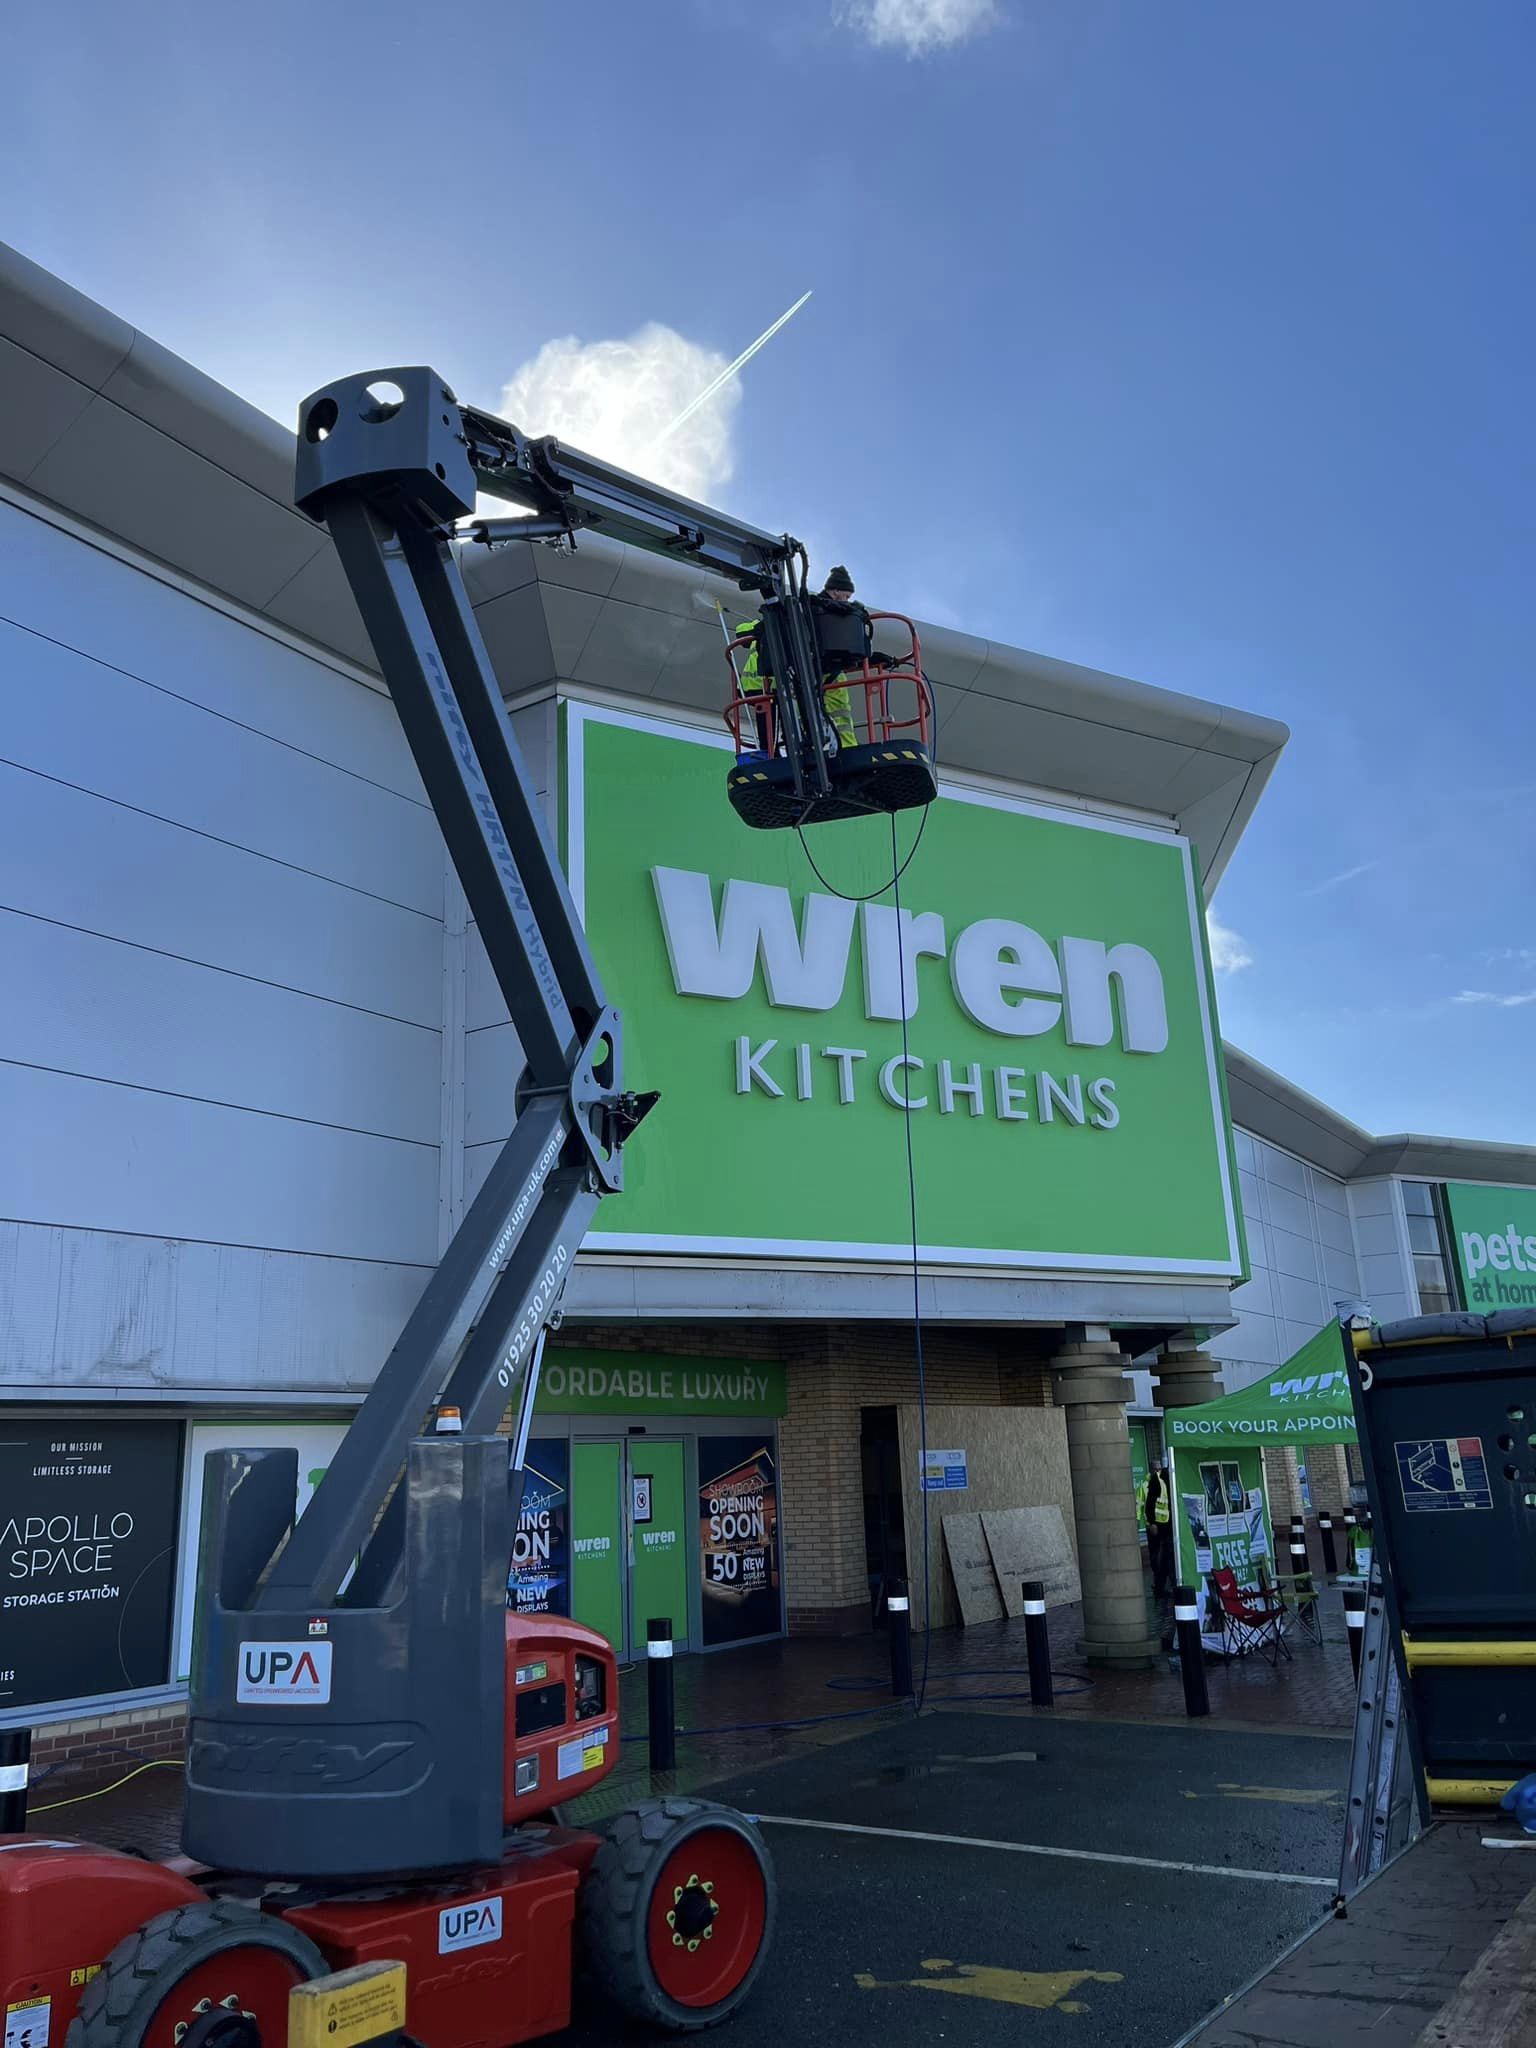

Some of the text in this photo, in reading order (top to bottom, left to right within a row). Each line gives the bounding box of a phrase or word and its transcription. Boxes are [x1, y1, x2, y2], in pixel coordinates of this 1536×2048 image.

[475, 792, 530, 911] HR17N
[524, 923, 563, 1009] Hybrid
[650, 865, 1169, 1055] wren
[734, 1036, 1120, 1130] KITCHENS
[488, 1138, 557, 1269] www.upa-uk.com
[1461, 1223, 1536, 1279] pets
[1472, 1277, 1494, 1302] at
[497, 1244, 568, 1388] 01925 30 20 20
[541, 1366, 769, 1400] ORDABLE LUXURY
[1280, 1389, 1350, 1403] KITCH
[1173, 1420, 1224, 1434] BOOK
[1228, 1419, 1278, 1433] YOUR
[51, 1442, 103, 1452] OUR MISSION
[33, 1465, 112, 1476] LIMITLESS STORAGE
[709, 1496, 764, 1514] OPENING
[0, 1512, 134, 1545] APOLLO
[517, 1511, 550, 1530] ING
[709, 1512, 765, 1541] SOON
[573, 1537, 610, 1552] wren
[642, 1530, 676, 1546] wren
[9, 1545, 113, 1578] SPACE
[712, 1551, 738, 1581] 50
[743, 1557, 764, 1571] NEW
[1216, 1540, 1250, 1569] FREE
[3, 1584, 120, 1608] STORAGE STATION
[516, 1586, 549, 1603] NEW
[516, 1602, 549, 1613] DISPLAYS
[245, 1651, 320, 1685] UPA
[445, 1906, 495, 1938] UPA
